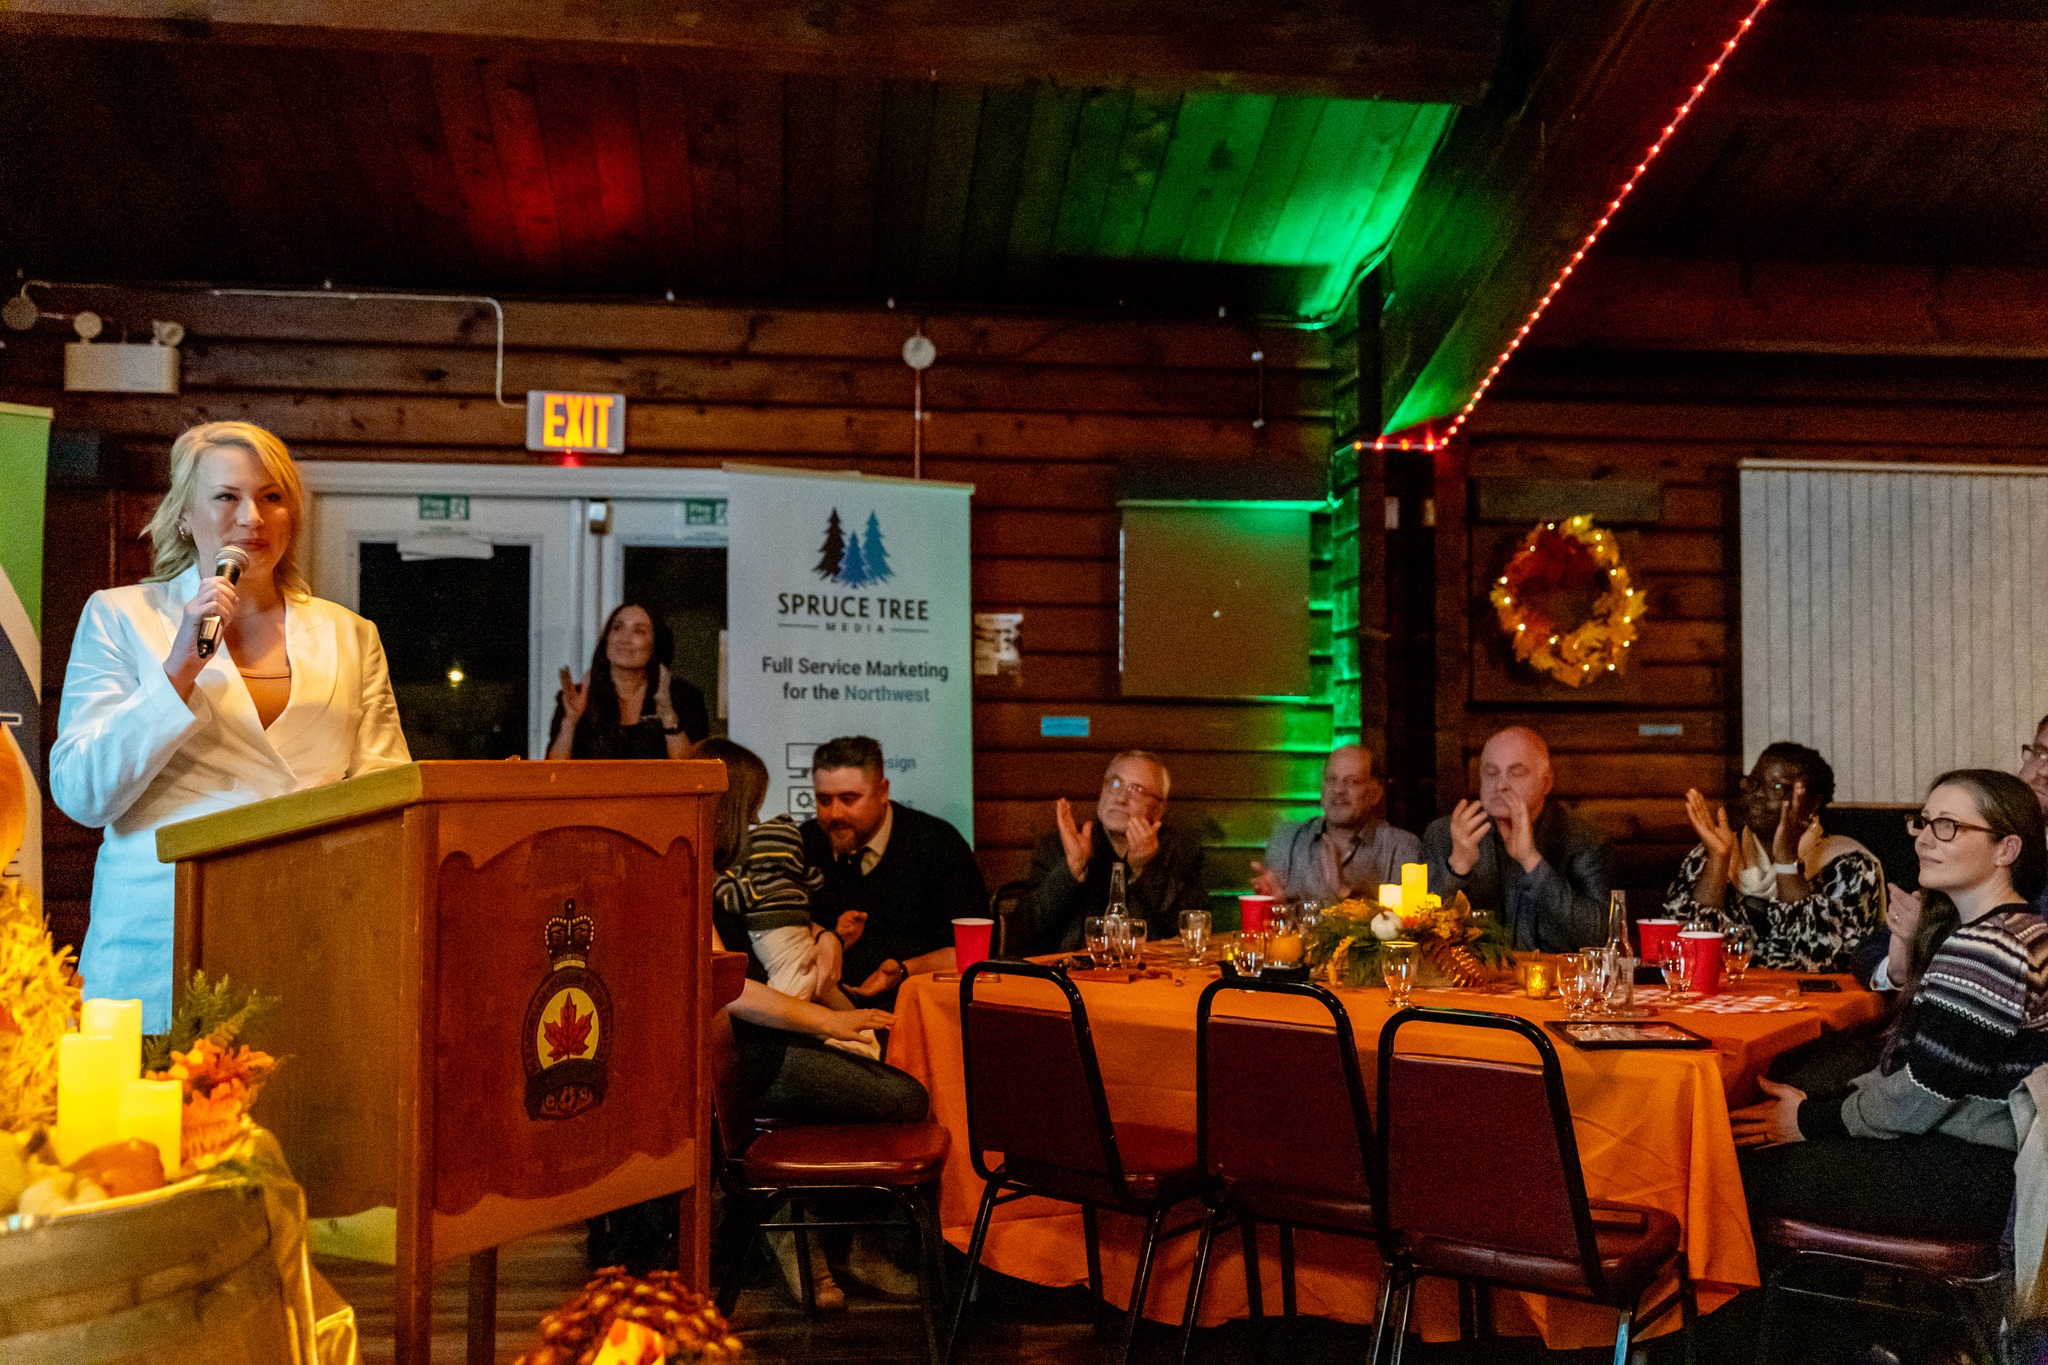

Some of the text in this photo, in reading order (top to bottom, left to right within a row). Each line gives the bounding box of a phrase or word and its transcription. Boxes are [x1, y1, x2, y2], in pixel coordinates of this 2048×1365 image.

[542, 393, 614, 449] EXIT
[778, 592, 929, 621] SPRUCE TREE
[825, 622, 885, 634] MEDIA
[762, 656, 950, 683] Full Service Marketing
[783, 681, 930, 703] for the Northwest
